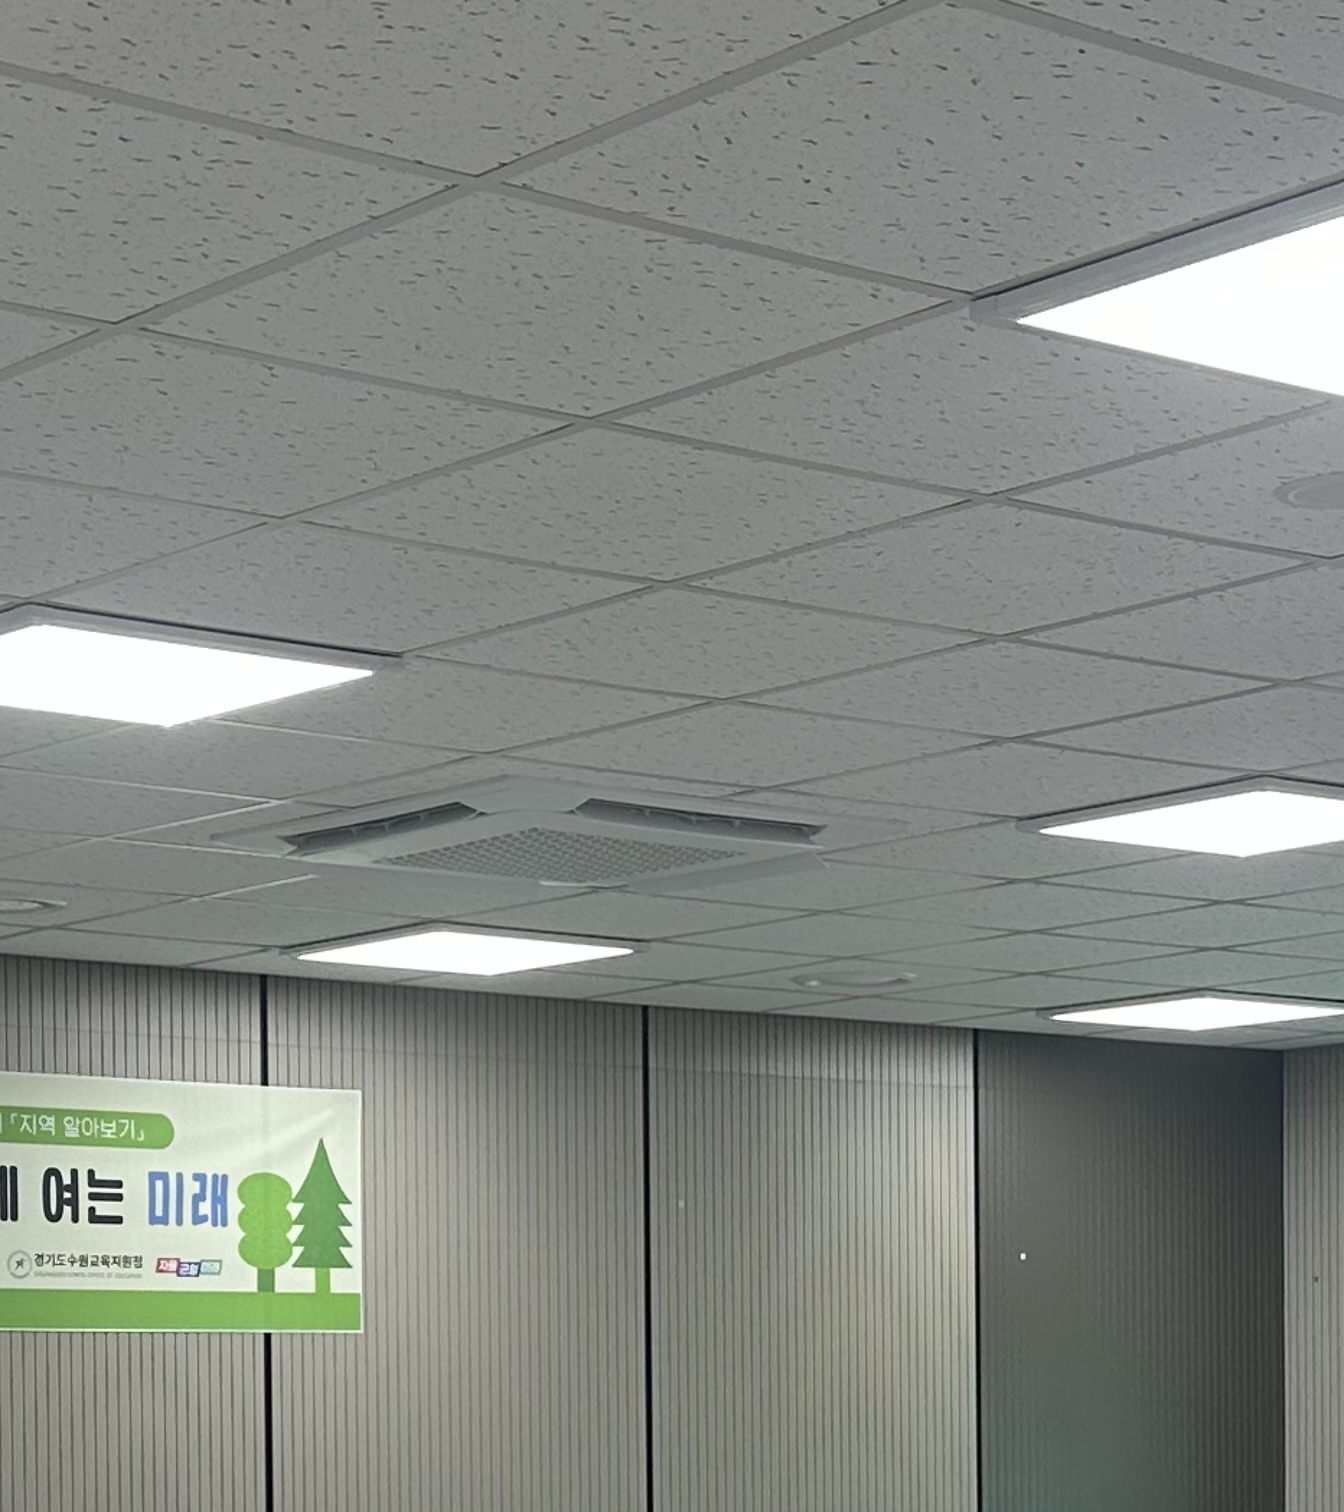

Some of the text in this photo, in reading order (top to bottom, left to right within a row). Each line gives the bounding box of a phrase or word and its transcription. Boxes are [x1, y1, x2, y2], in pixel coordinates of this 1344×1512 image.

[9, 1112, 56, 1136] 「지역
[63, 1115, 145, 1141] 알아보기」
[42, 1167, 124, 1225] 여는
[147, 1170, 229, 1227] 미래
[33, 1253, 144, 1269] 경기도수원교육지원청
